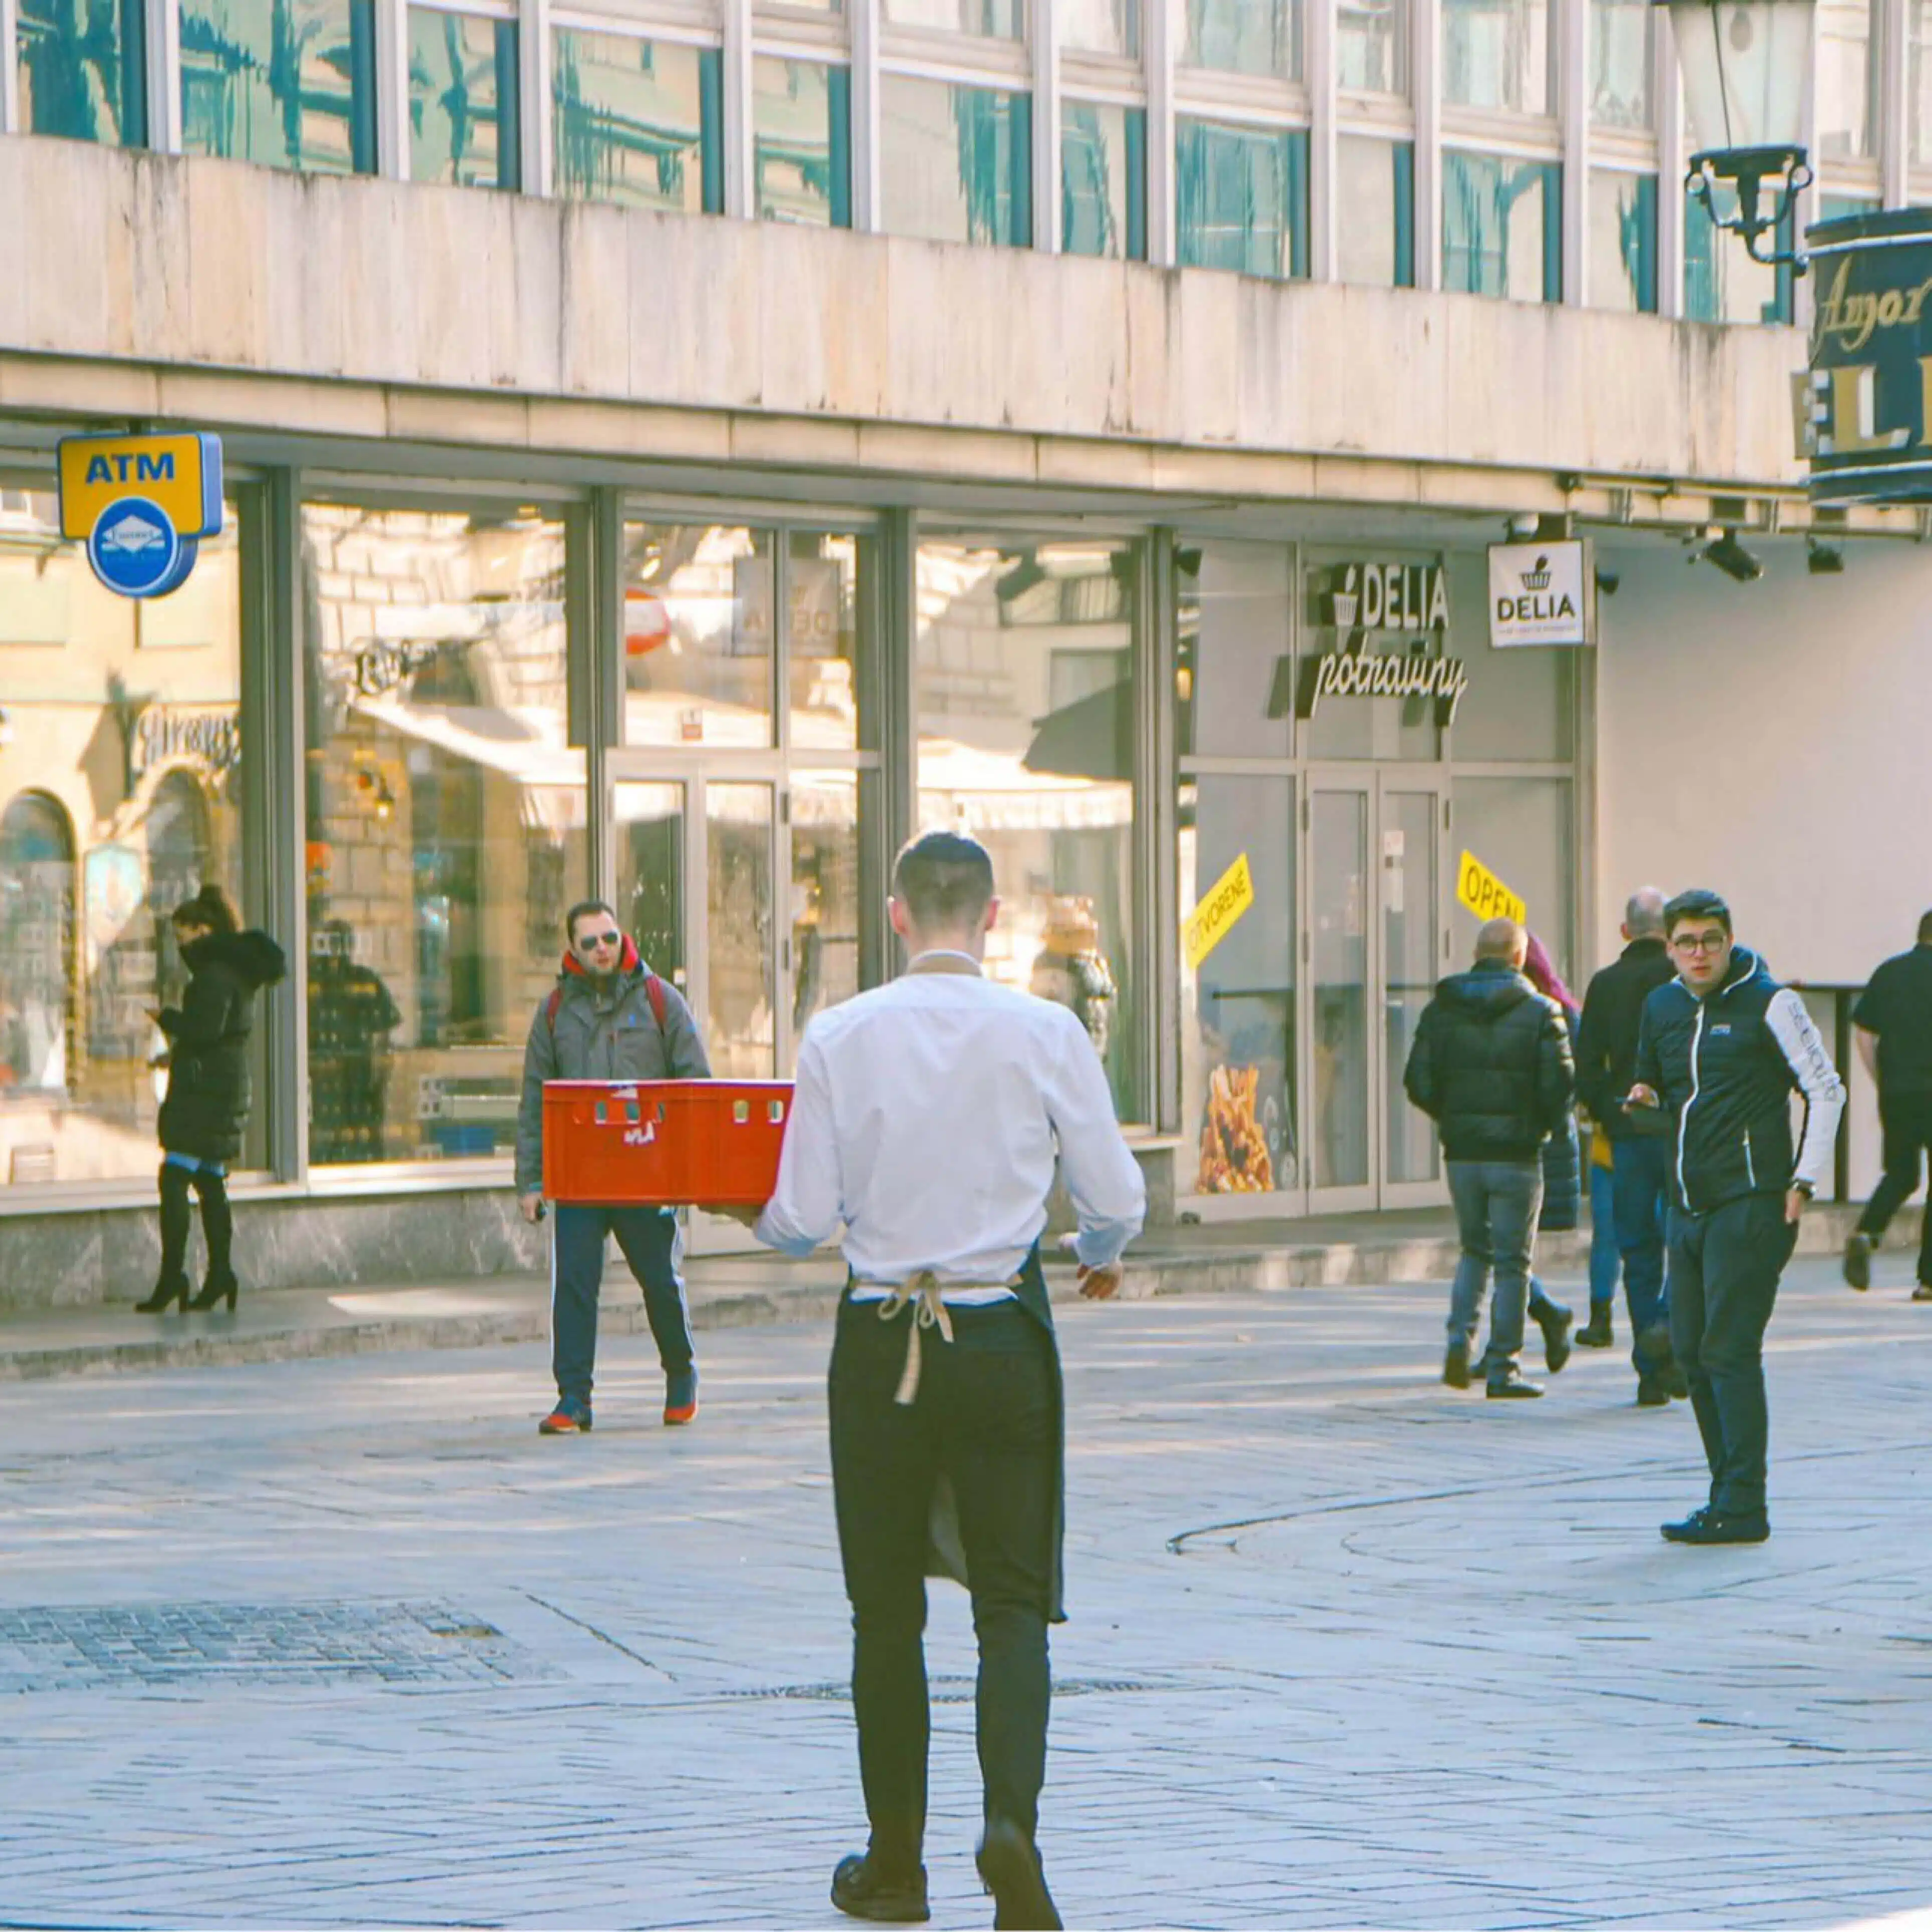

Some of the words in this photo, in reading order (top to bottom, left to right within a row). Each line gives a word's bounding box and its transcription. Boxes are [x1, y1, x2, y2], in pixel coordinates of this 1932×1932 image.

[86, 453, 175, 484] ATM
[1362, 564, 1449, 629] DELIA
[1497, 593, 1576, 621] DELIA
[1309, 631, 1469, 725] potraviny
[1466, 865, 1518, 921] OPEN
